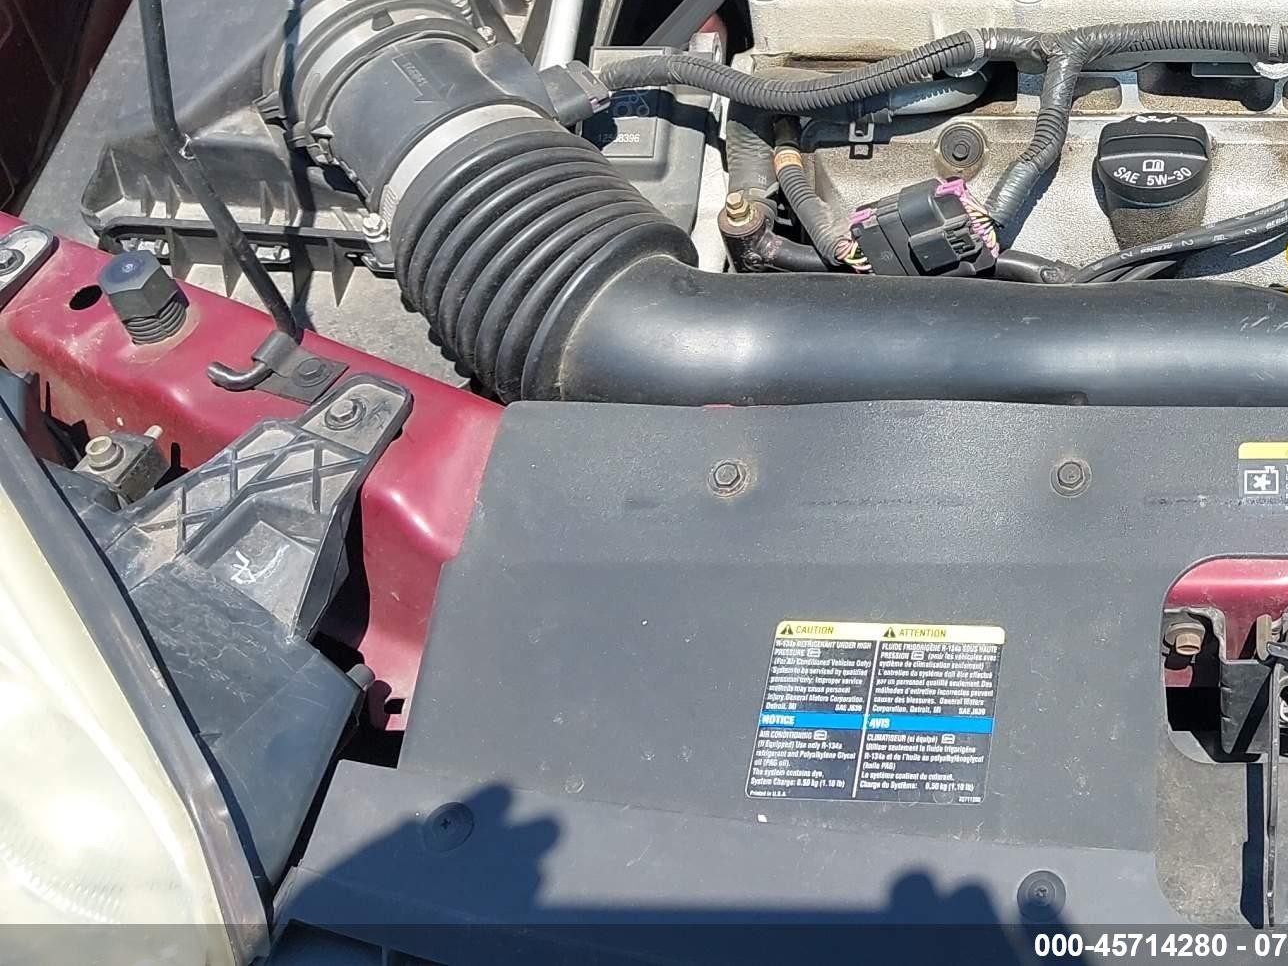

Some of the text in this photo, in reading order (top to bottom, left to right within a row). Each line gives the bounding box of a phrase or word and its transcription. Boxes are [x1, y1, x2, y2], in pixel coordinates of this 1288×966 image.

[1114, 166, 1192, 186] SAE 5W-30
[796, 626, 833, 634] CAUTION
[899, 629, 946, 637] ATTENTION
[762, 715, 795, 724] NOTICE
[869, 718, 890, 728] AVIS
[752, 768, 764, 776] The
[750, 778, 772, 786] System
